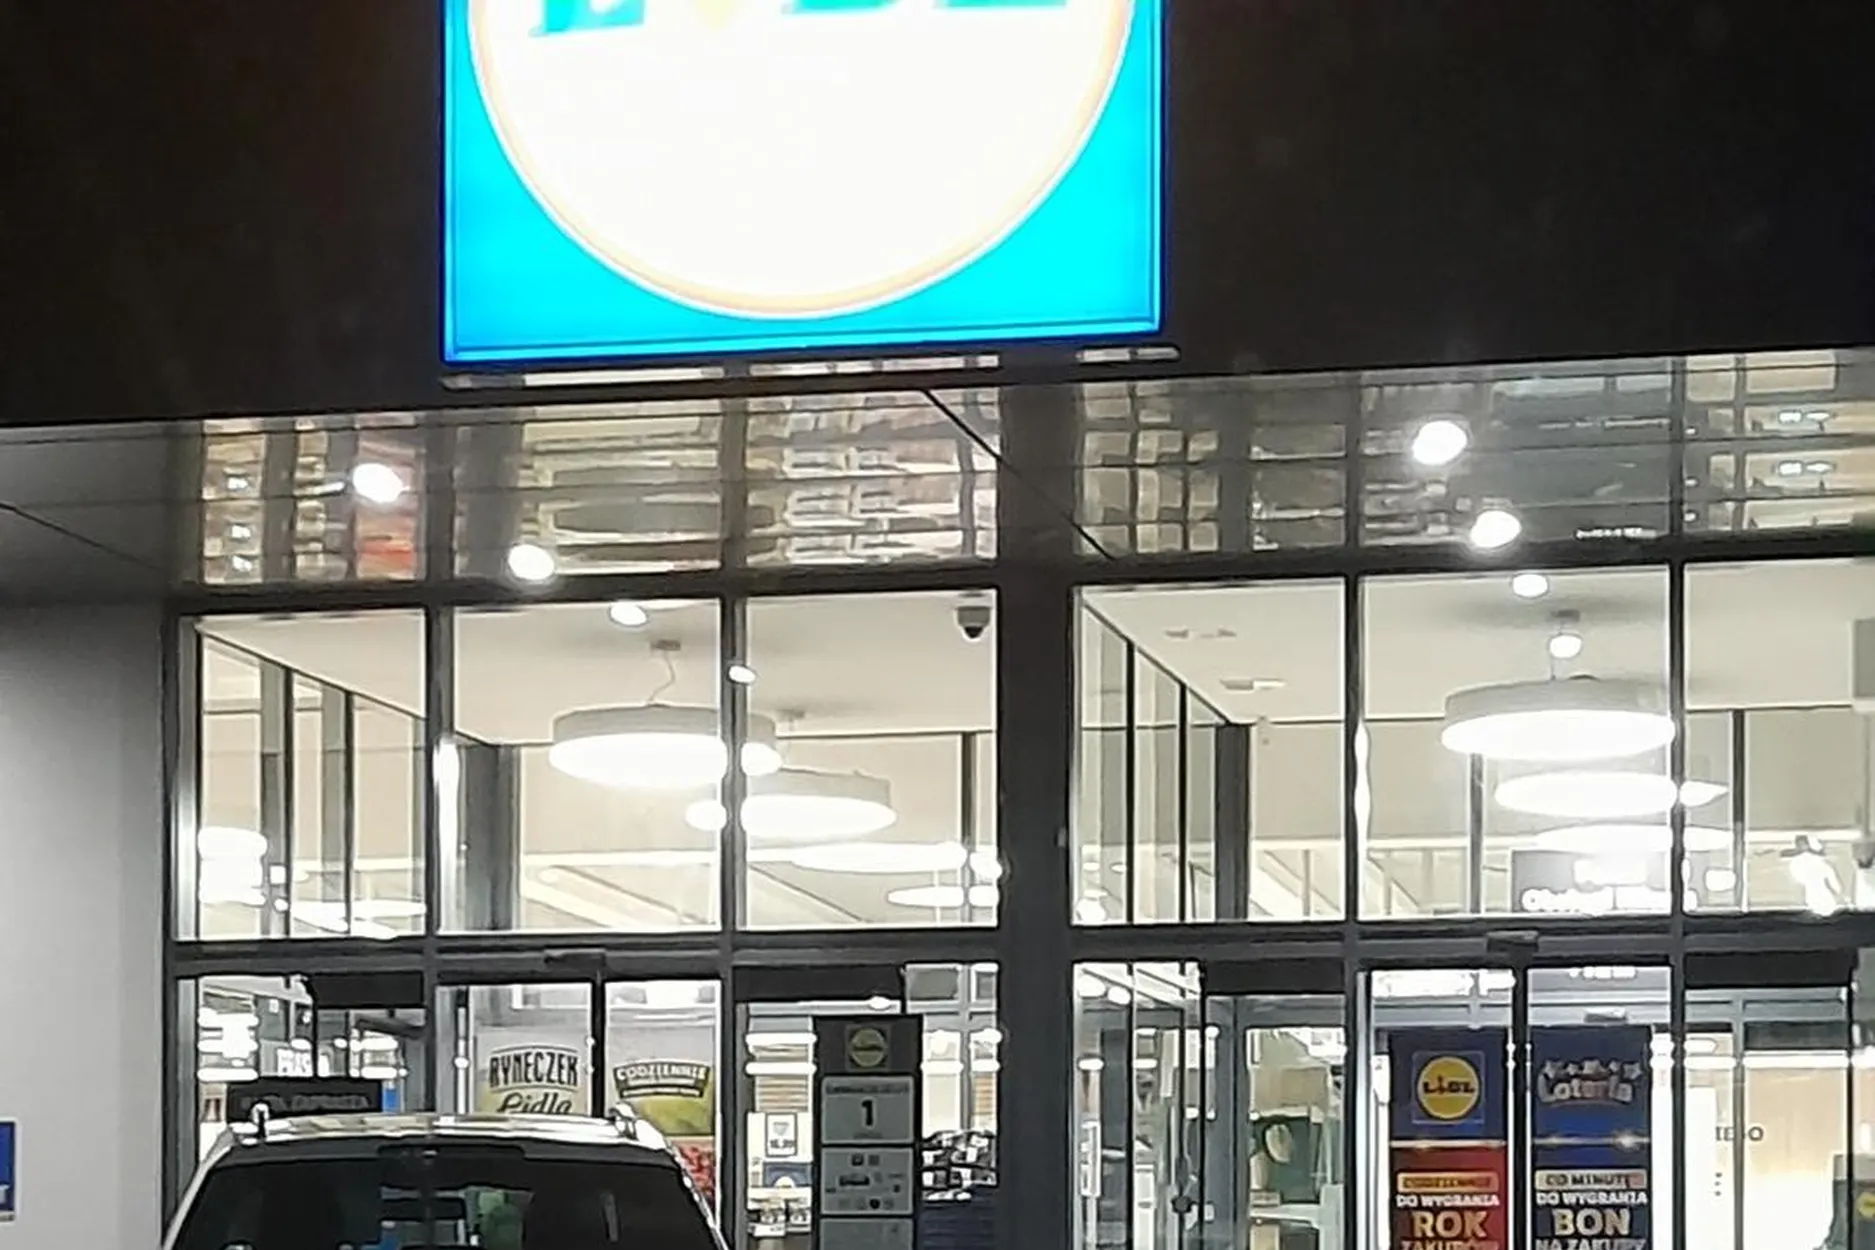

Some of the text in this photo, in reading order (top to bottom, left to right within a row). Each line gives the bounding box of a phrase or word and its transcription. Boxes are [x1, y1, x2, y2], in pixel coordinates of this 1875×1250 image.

[489, 1051, 578, 1088] RYNECZEK
[861, 1100, 873, 1126] 1
[1535, 1191, 1560, 1205] DO
[1411, 1210, 1488, 1238] ROK
[1551, 1208, 1630, 1236] BON
